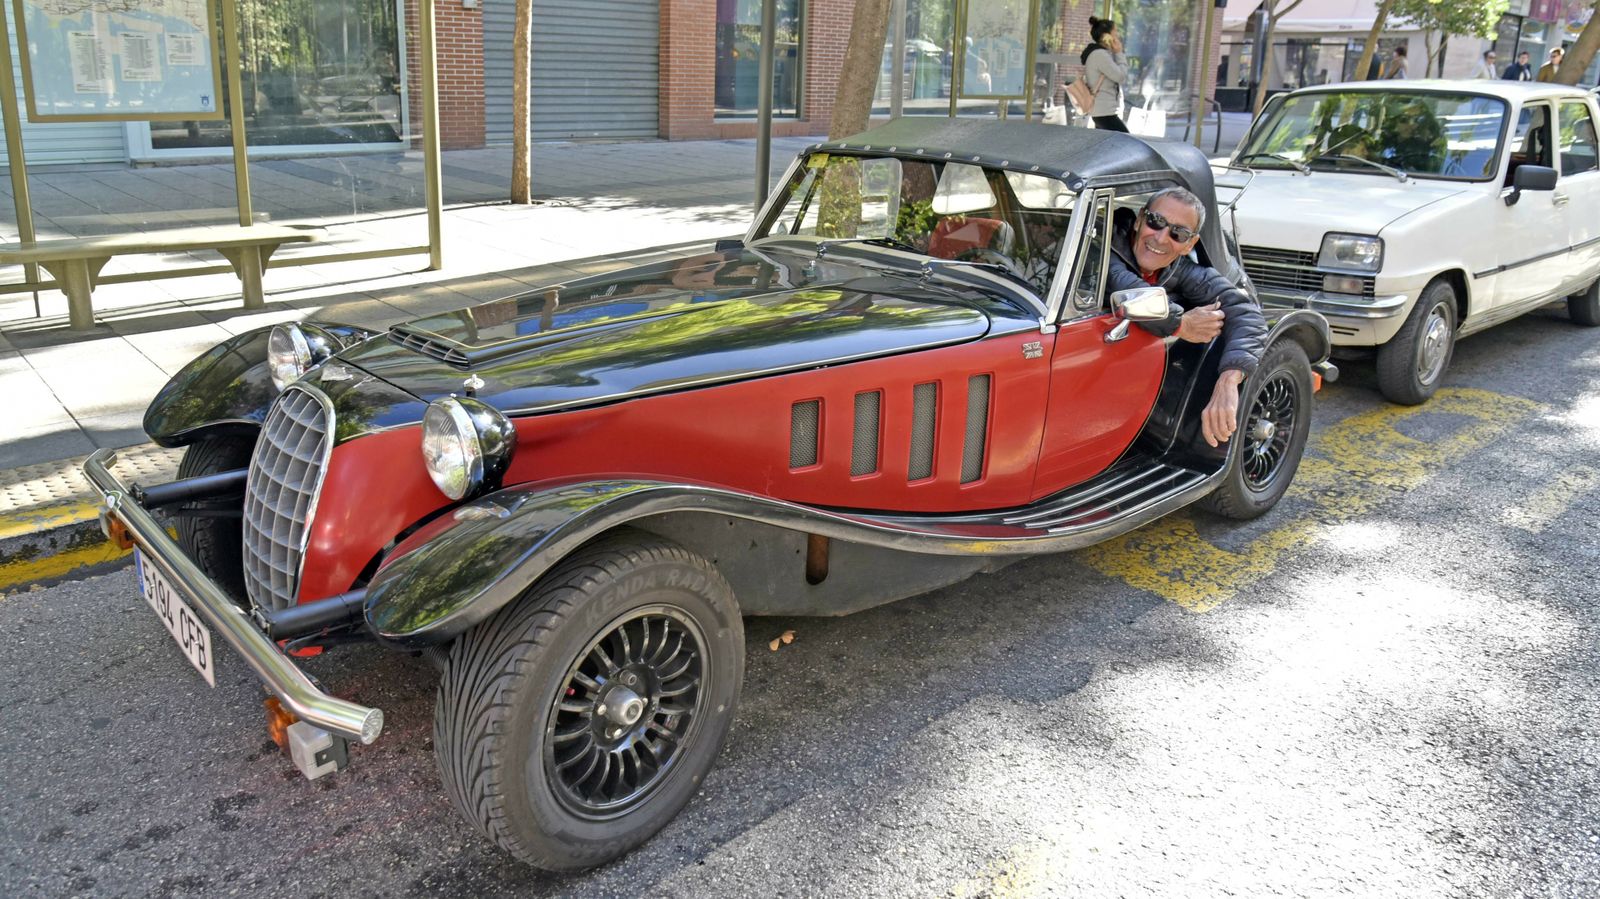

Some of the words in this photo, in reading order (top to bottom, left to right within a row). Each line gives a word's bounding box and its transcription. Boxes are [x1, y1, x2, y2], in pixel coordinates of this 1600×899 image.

[142, 560, 174, 630] 5194
[180, 607, 206, 671] CFB
[585, 570, 657, 627] KENDA
